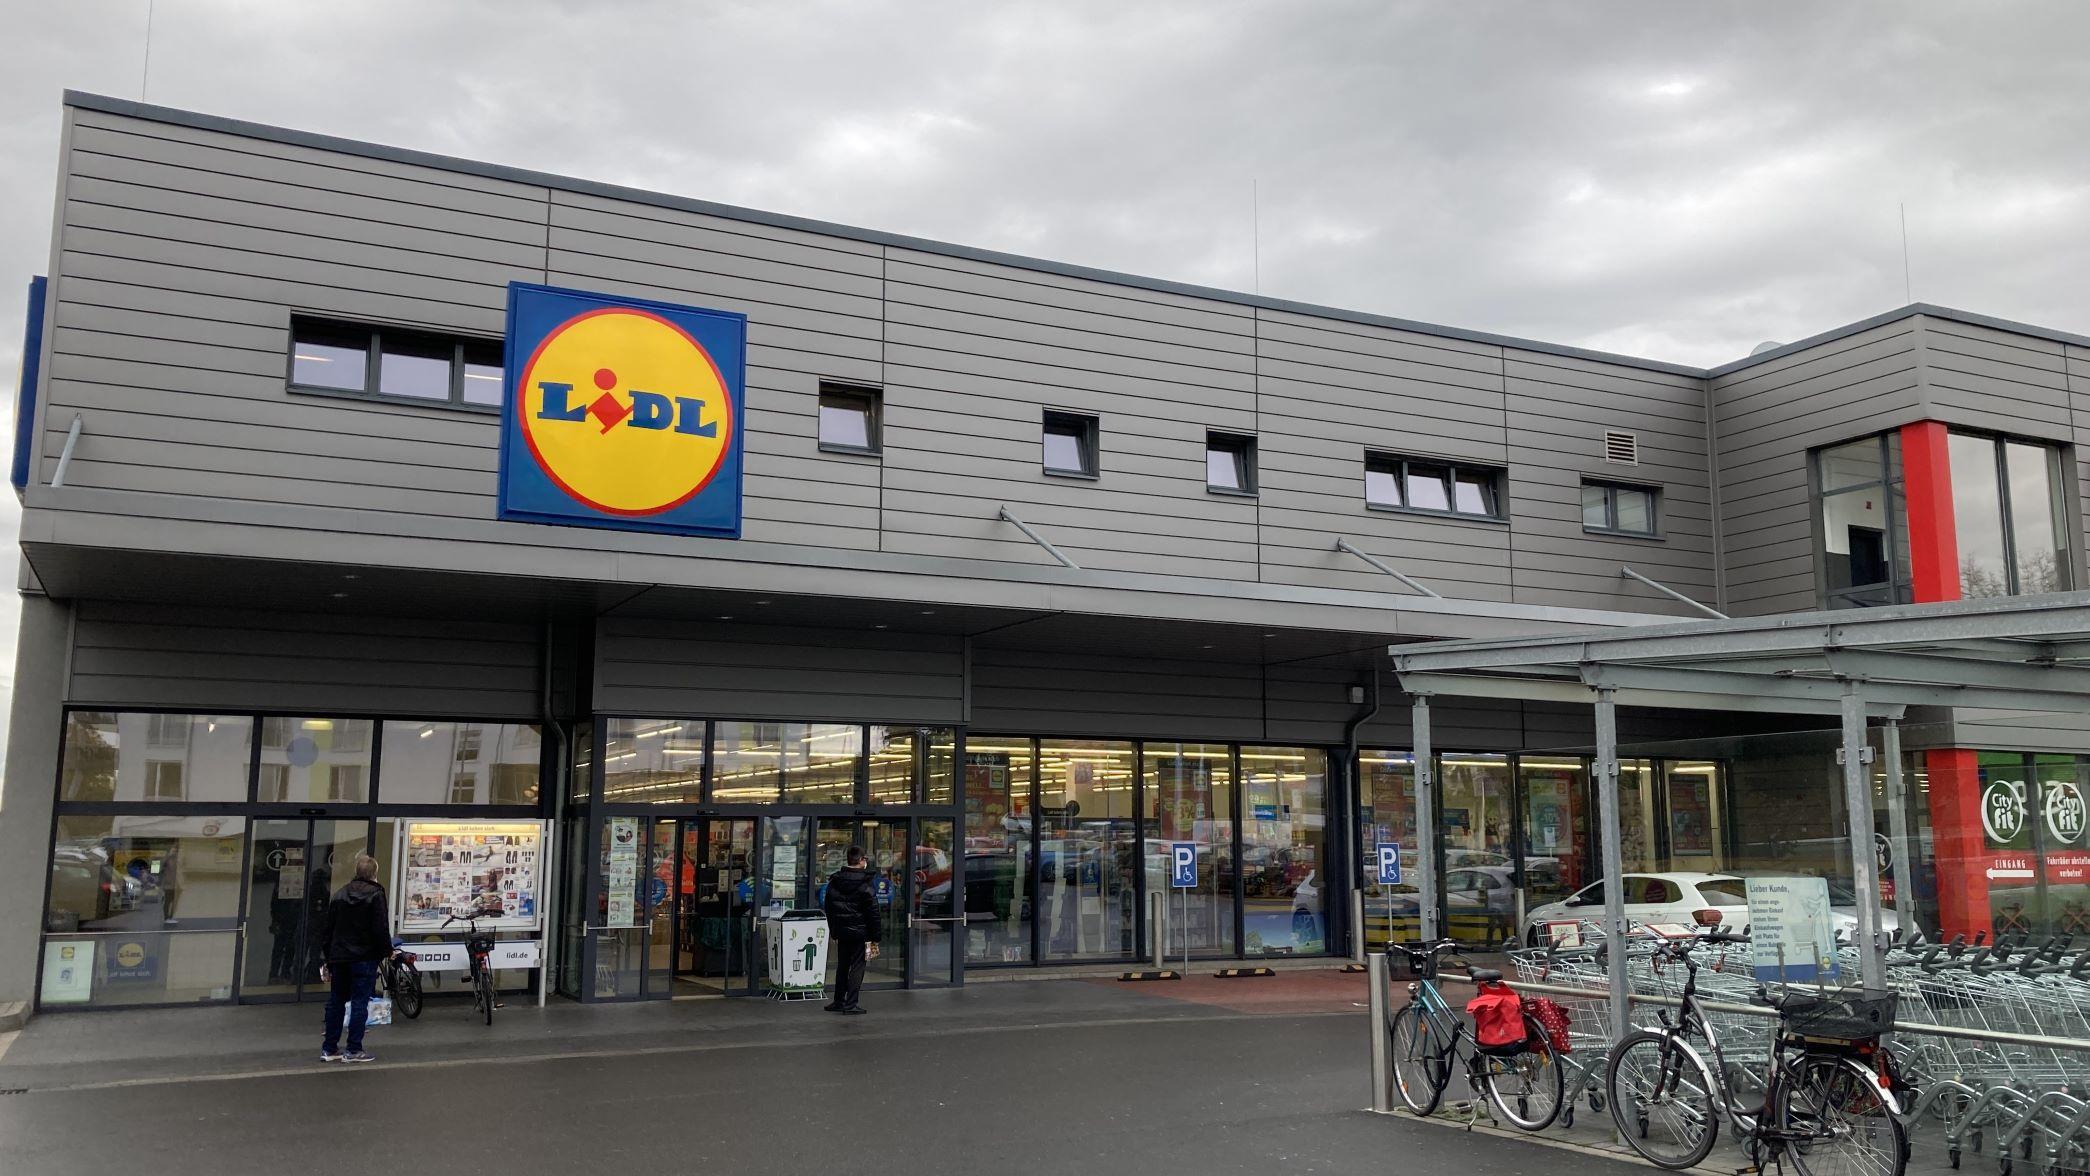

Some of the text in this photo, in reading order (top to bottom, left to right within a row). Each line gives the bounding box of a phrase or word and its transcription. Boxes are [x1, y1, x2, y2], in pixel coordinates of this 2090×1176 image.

[1992, 793, 2013, 811] City
[2056, 796, 2077, 814] City
[1994, 807, 2015, 830] fit
[2058, 809, 2079, 831] fit
[1175, 847, 1194, 880] P
[1380, 847, 1397, 878] P
[1995, 860, 2026, 869] EINGANG
[2047, 856, 2090, 865] Fahrräder abstelle
[2060, 869, 2083, 877] verboten!
[1750, 885, 1790, 893] Lieber Kunde,
